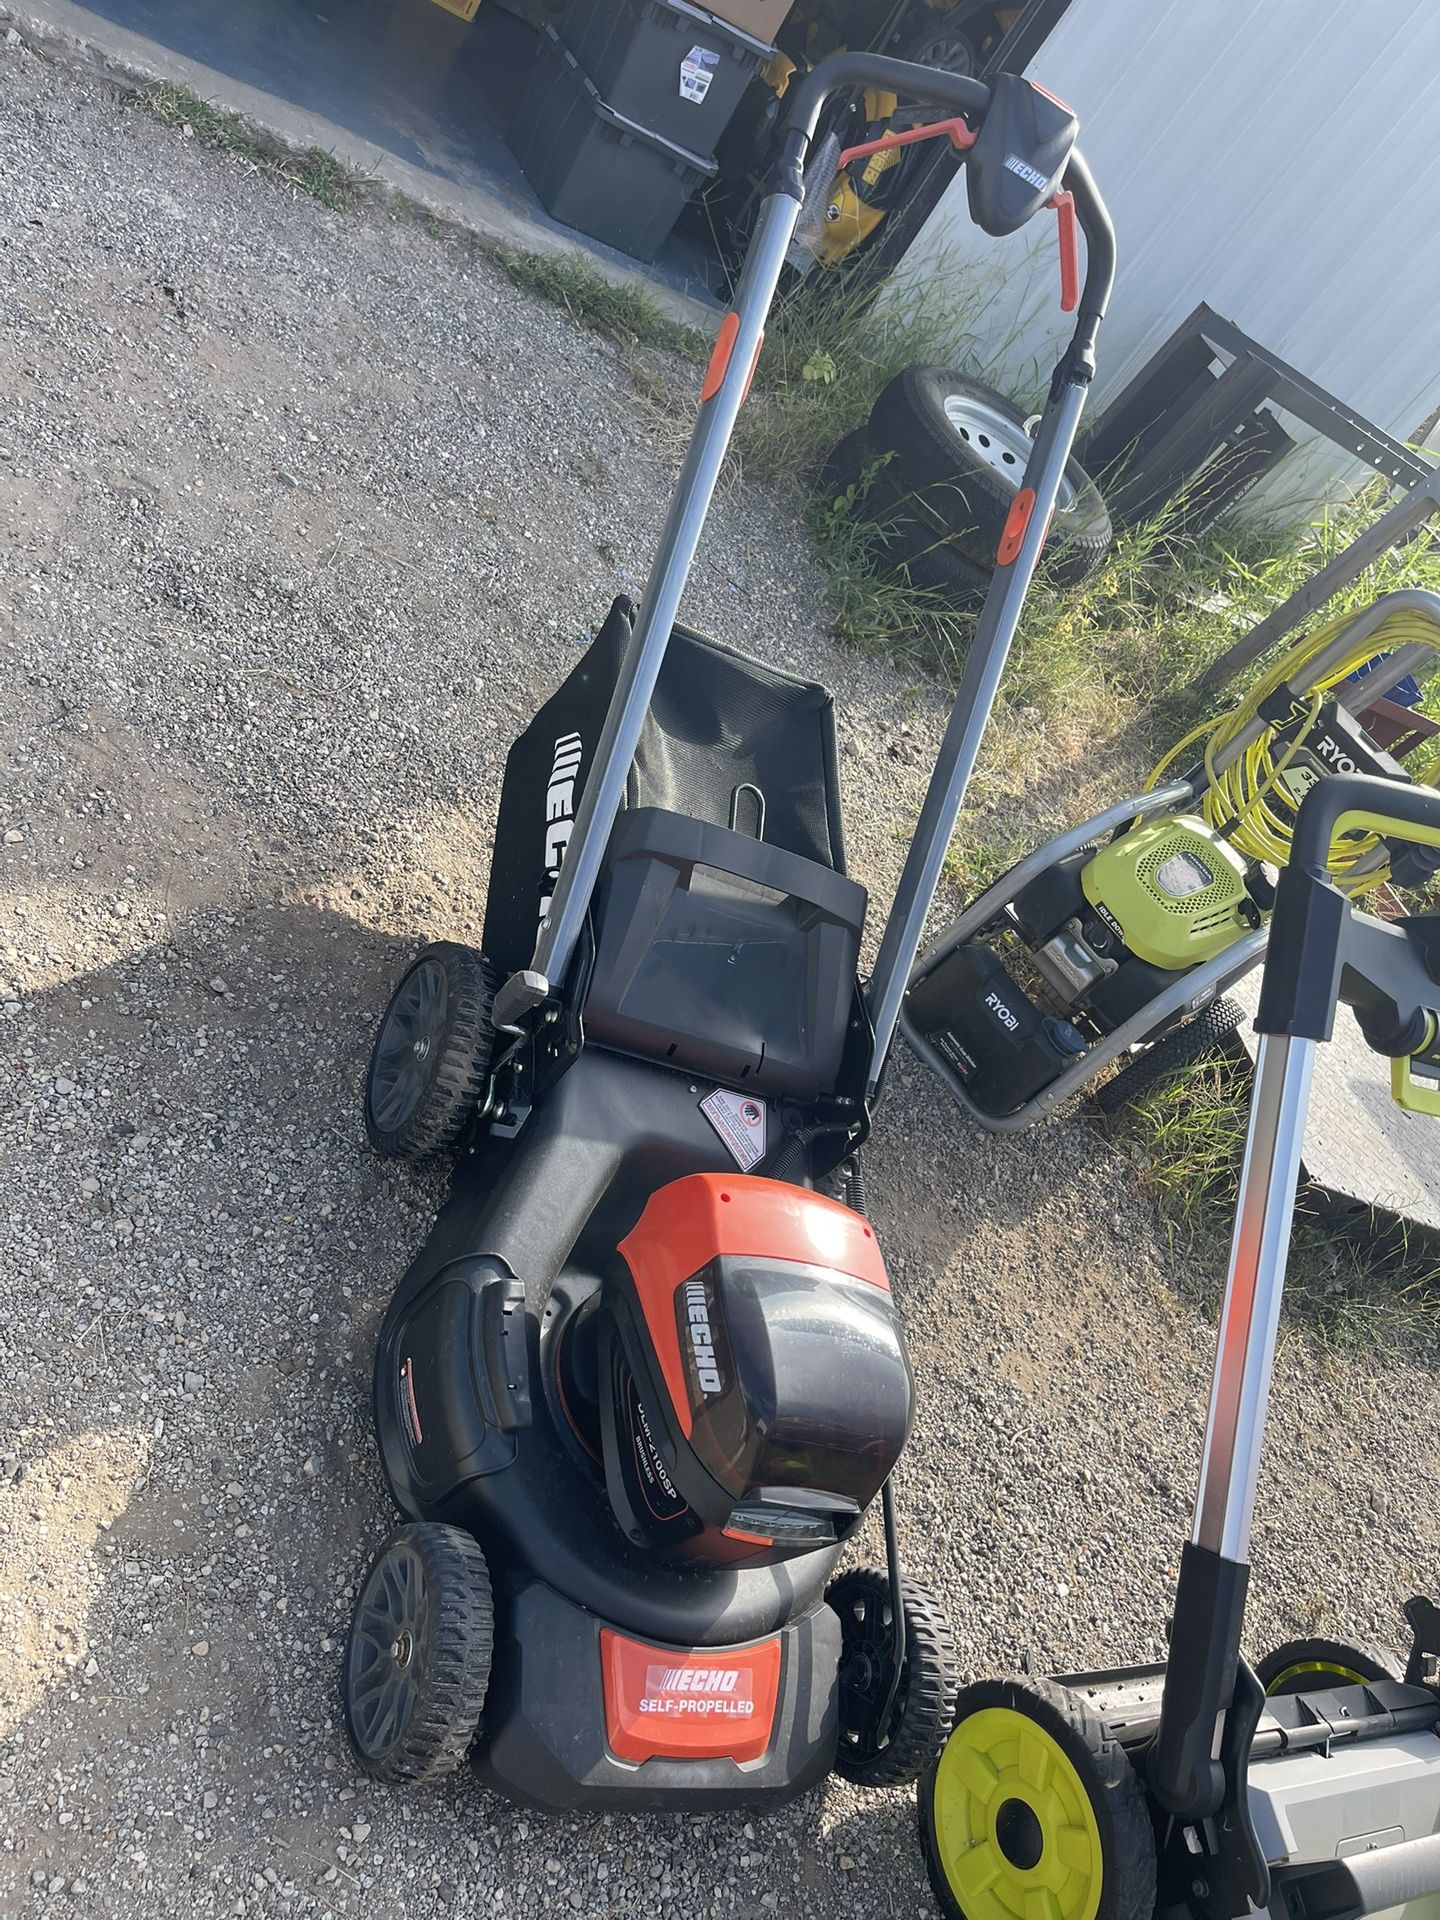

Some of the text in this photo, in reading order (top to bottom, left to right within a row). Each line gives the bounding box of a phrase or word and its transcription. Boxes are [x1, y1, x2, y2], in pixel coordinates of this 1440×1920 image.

[1012, 161, 1048, 191] ECHO
[1196, 476, 1258, 539] Shop Press 60,000
[1316, 735, 1363, 774] RYO
[1098, 905, 1125, 938] IDLE DOW
[985, 992, 1020, 1032] RYOBI
[687, 1304, 722, 1392] ECHO
[635, 1436, 655, 1484] BRUSHLESS
[675, 1669, 739, 1692] ECHO
[639, 1698, 755, 1714] SELF-PROPELLED
